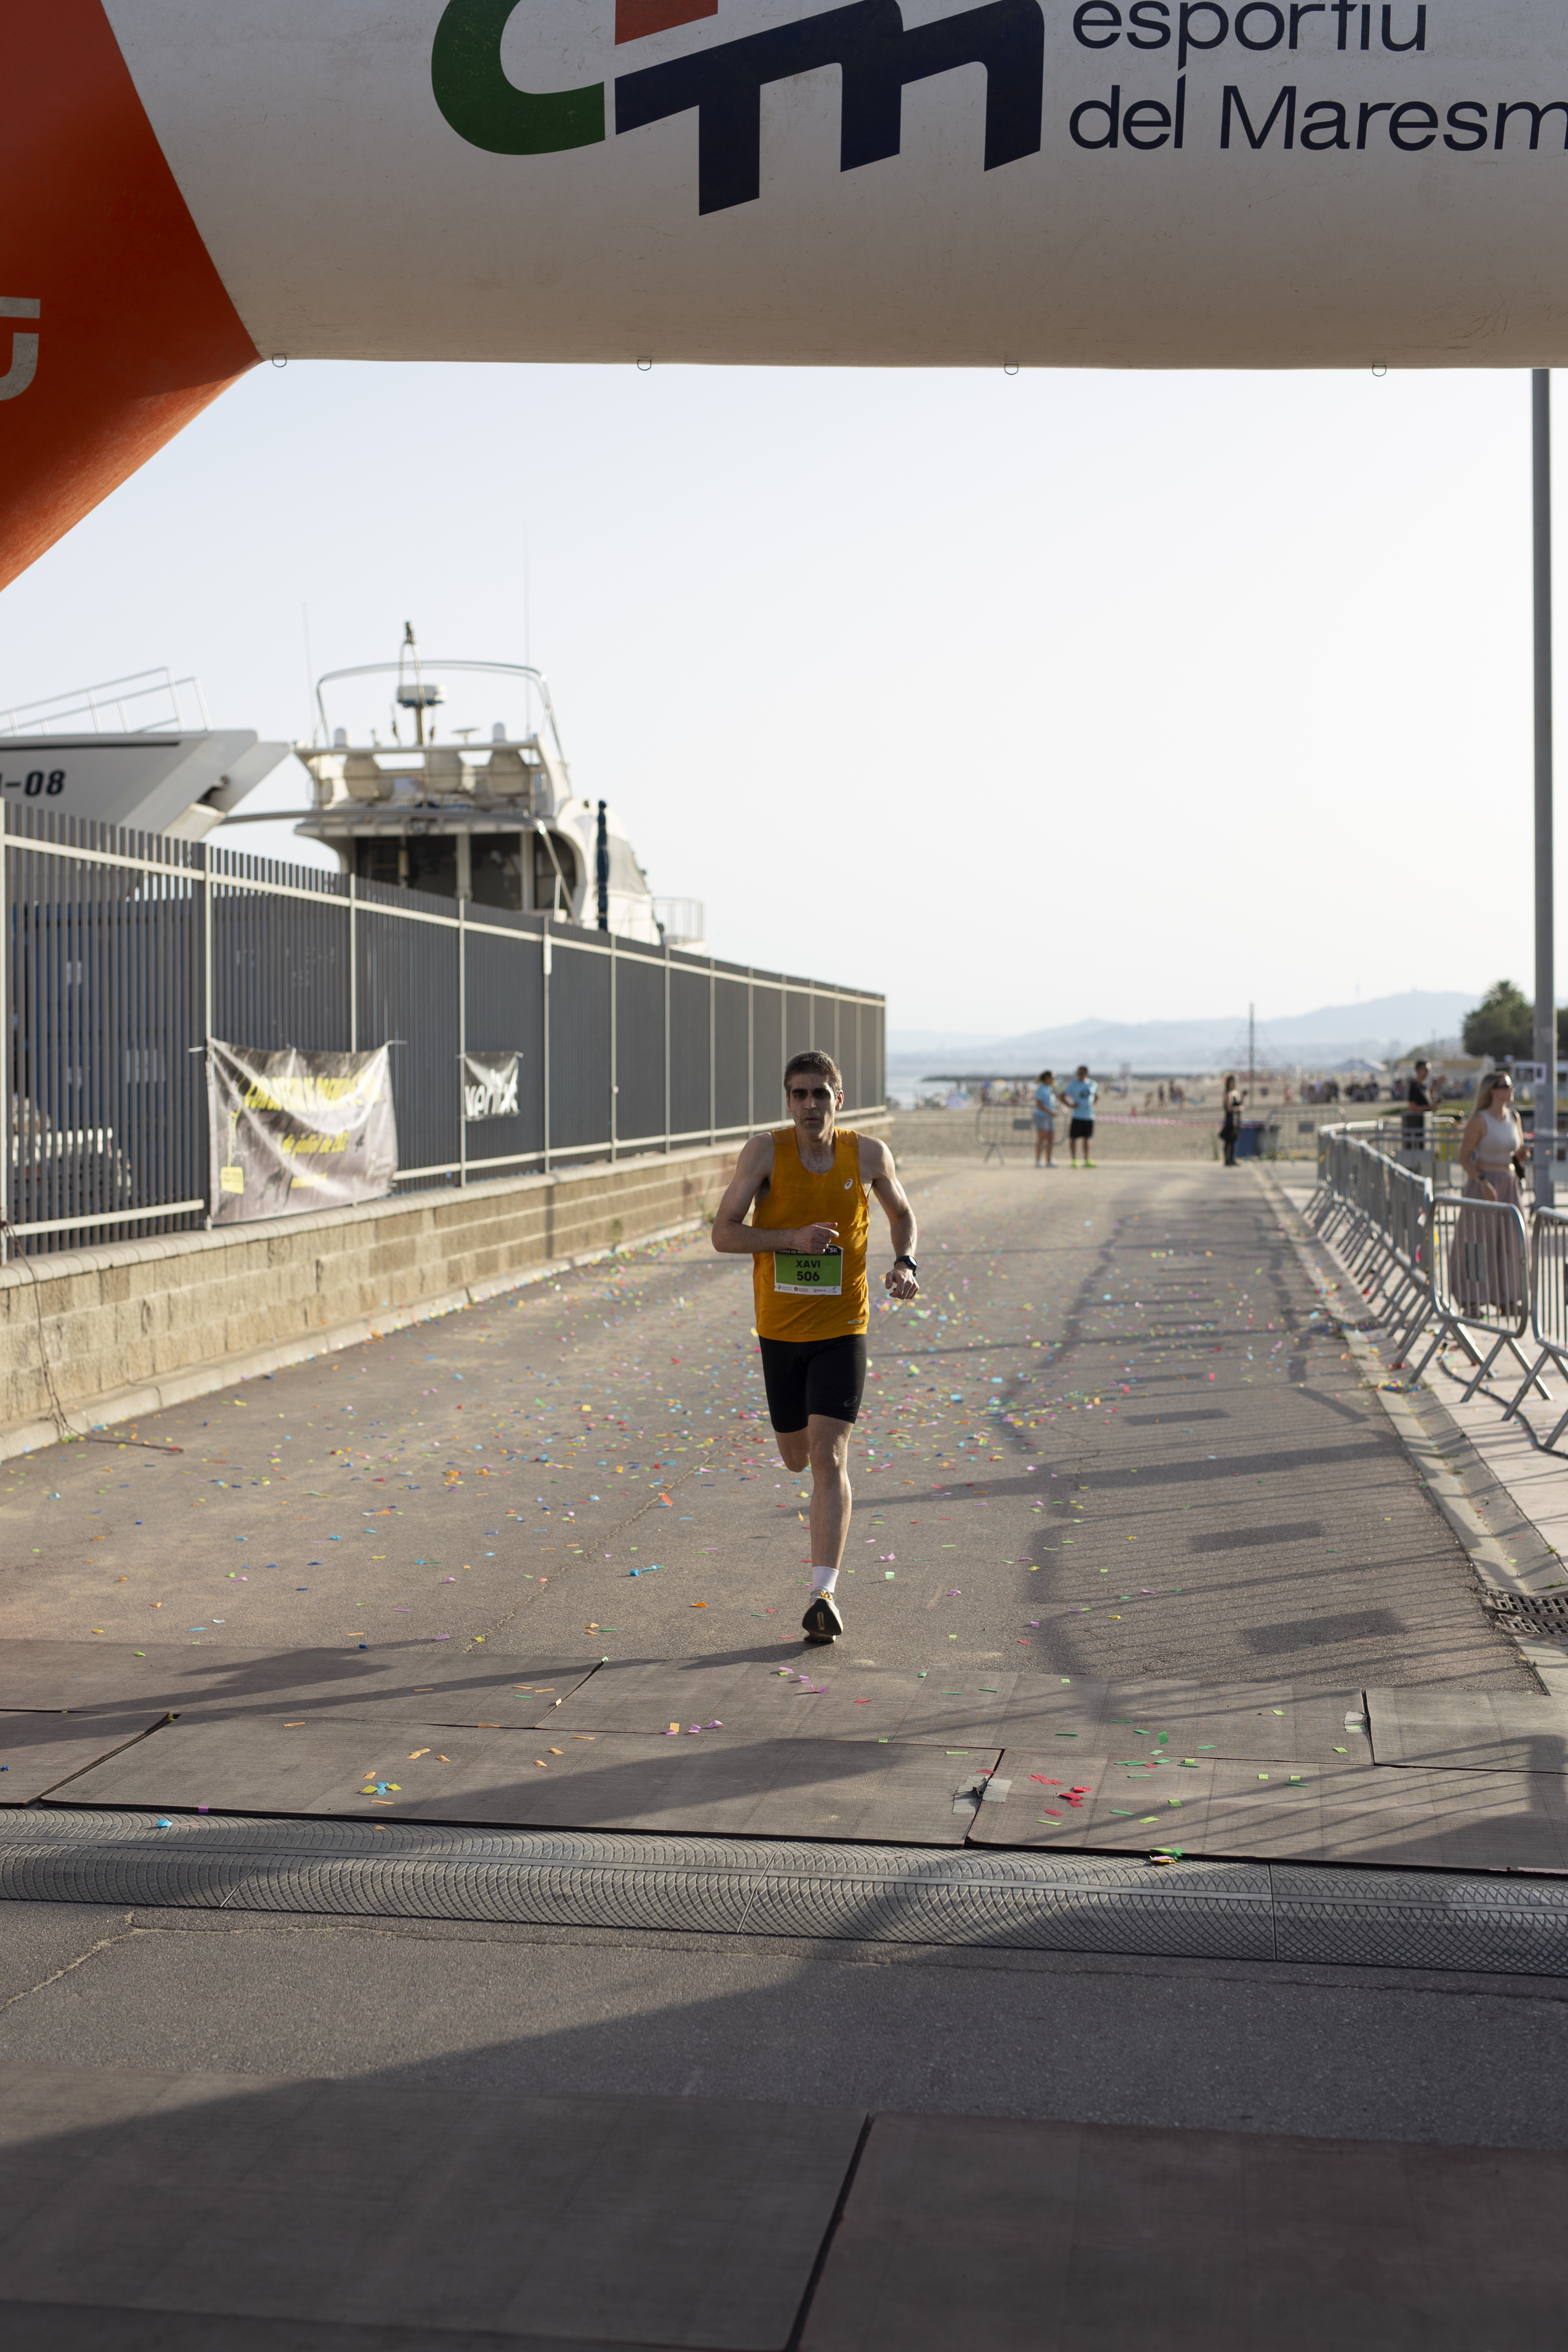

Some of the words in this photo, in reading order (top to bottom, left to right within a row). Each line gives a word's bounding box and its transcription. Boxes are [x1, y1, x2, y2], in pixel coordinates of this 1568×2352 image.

[1073, 0, 1427, 71] esportiu
[1069, 74, 1186, 150] del
[1220, 85, 1568, 151] Maresm
[796, 1260, 820, 1268] XAVI
[796, 1271, 820, 1281] 506
